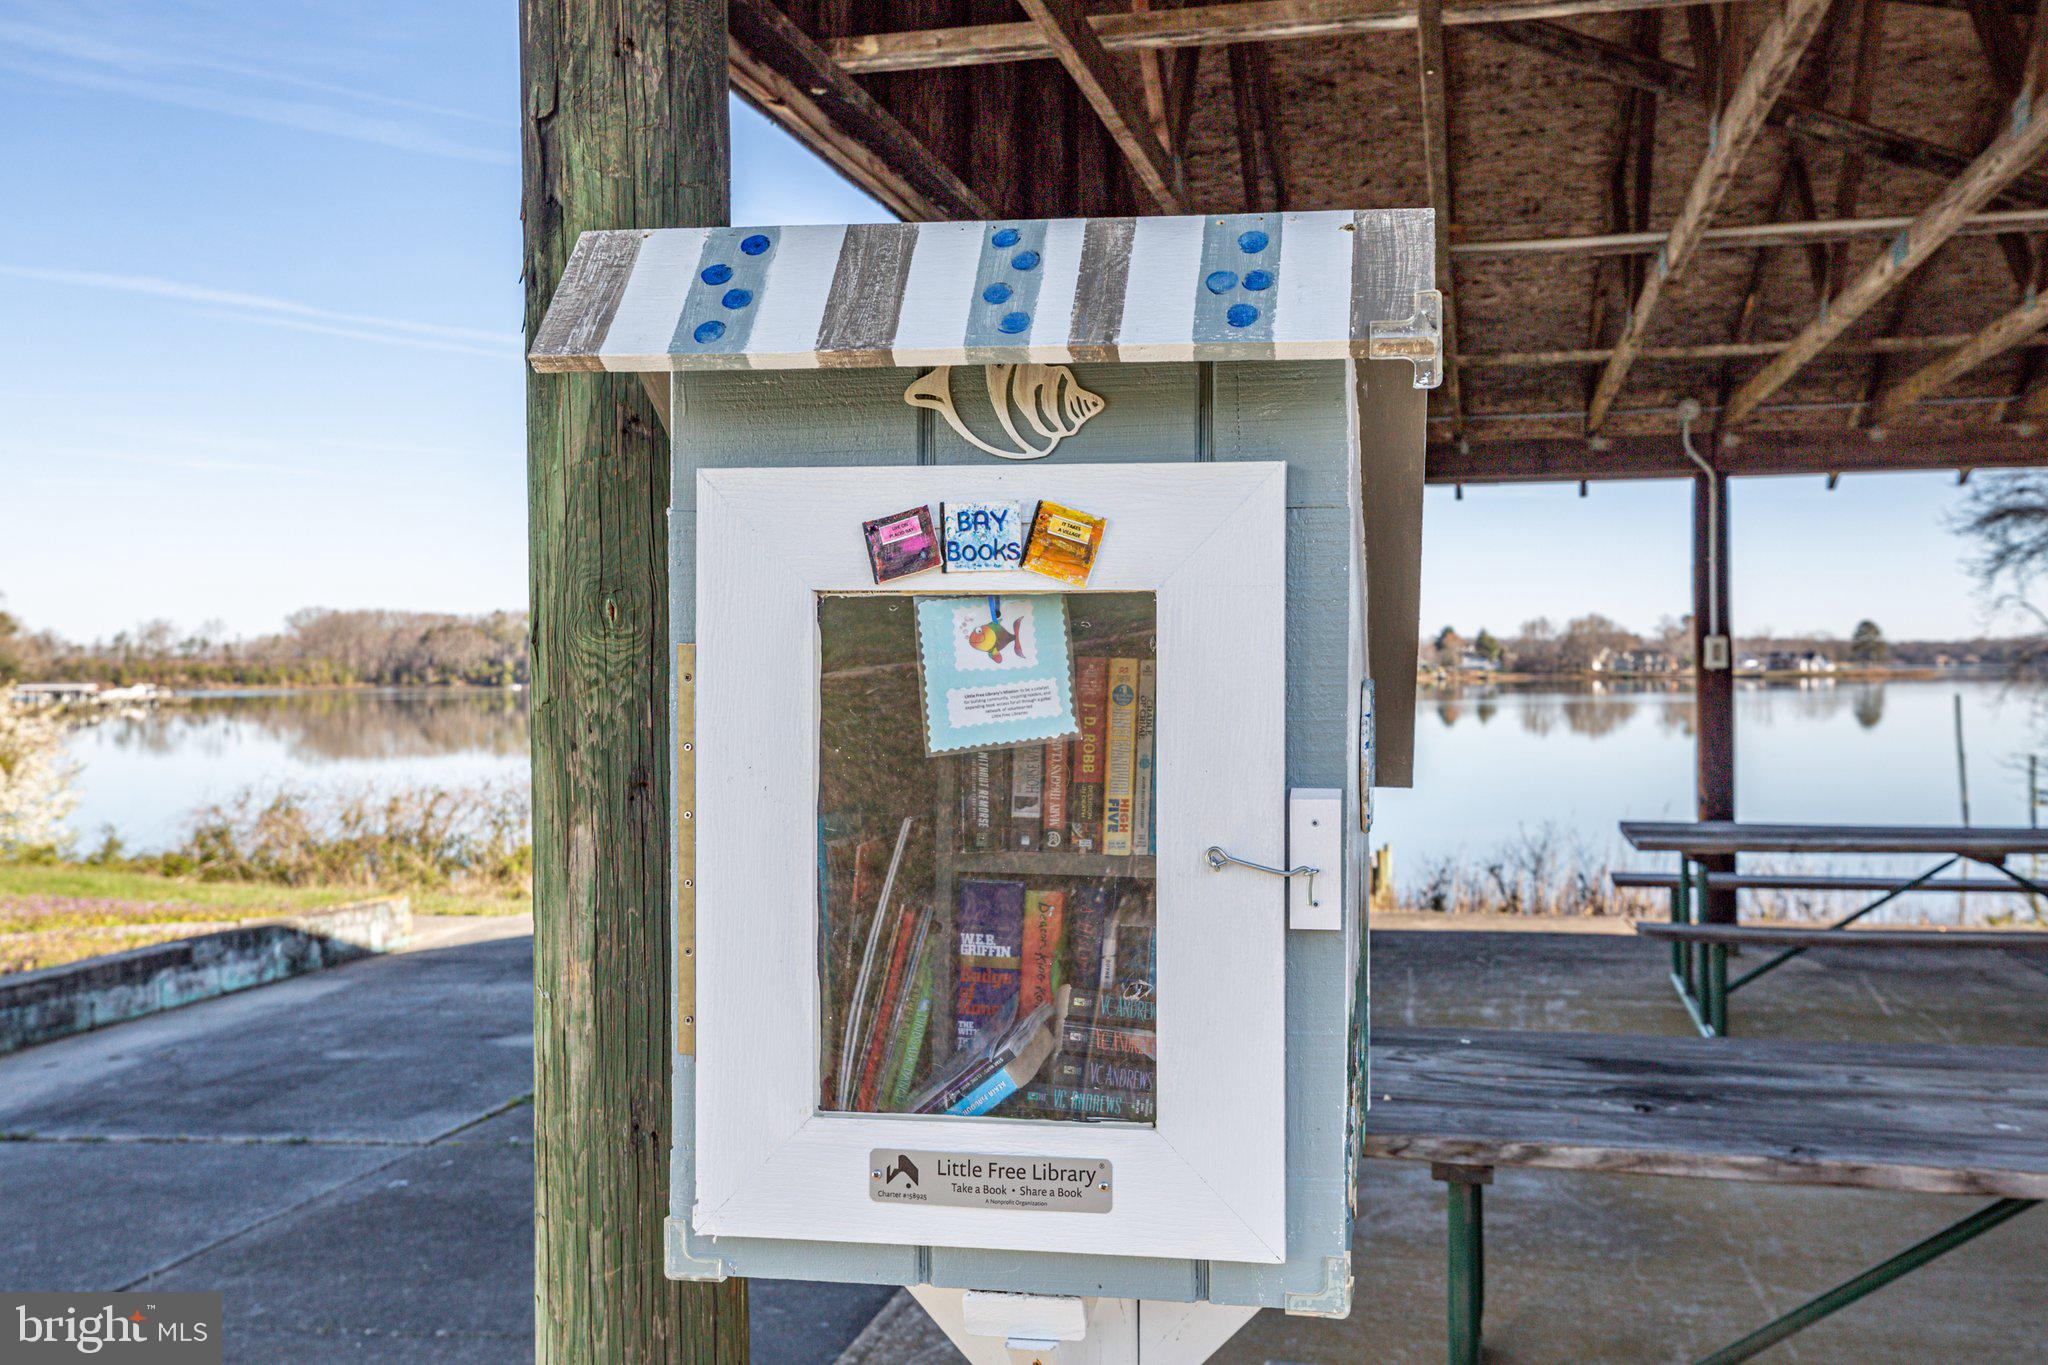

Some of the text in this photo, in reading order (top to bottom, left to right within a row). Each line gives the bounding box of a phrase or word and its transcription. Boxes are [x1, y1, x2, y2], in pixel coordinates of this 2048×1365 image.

[956, 509, 1009, 533] BAY
[1082, 733, 1096, 774] ROBB
[977, 751, 989, 828] WITHOUT REMORSE
[1050, 740, 1062, 827] MARY HIGGINS CLAR
[1107, 798, 1120, 833] FIVE
[1119, 798, 1130, 833] HIGH
[960, 944, 1012, 958] GRIFFIN
[957, 1020, 974, 1029] THE
[937, 1159, 1097, 1187] Little Free Library
[877, 1189, 902, 1199] Charter
[951, 1183, 1082, 1198] Take a Book Share a Book
[990, 1199, 1014, 1207] Nonprofit
[1015, 1200, 1048, 1208] Organization
